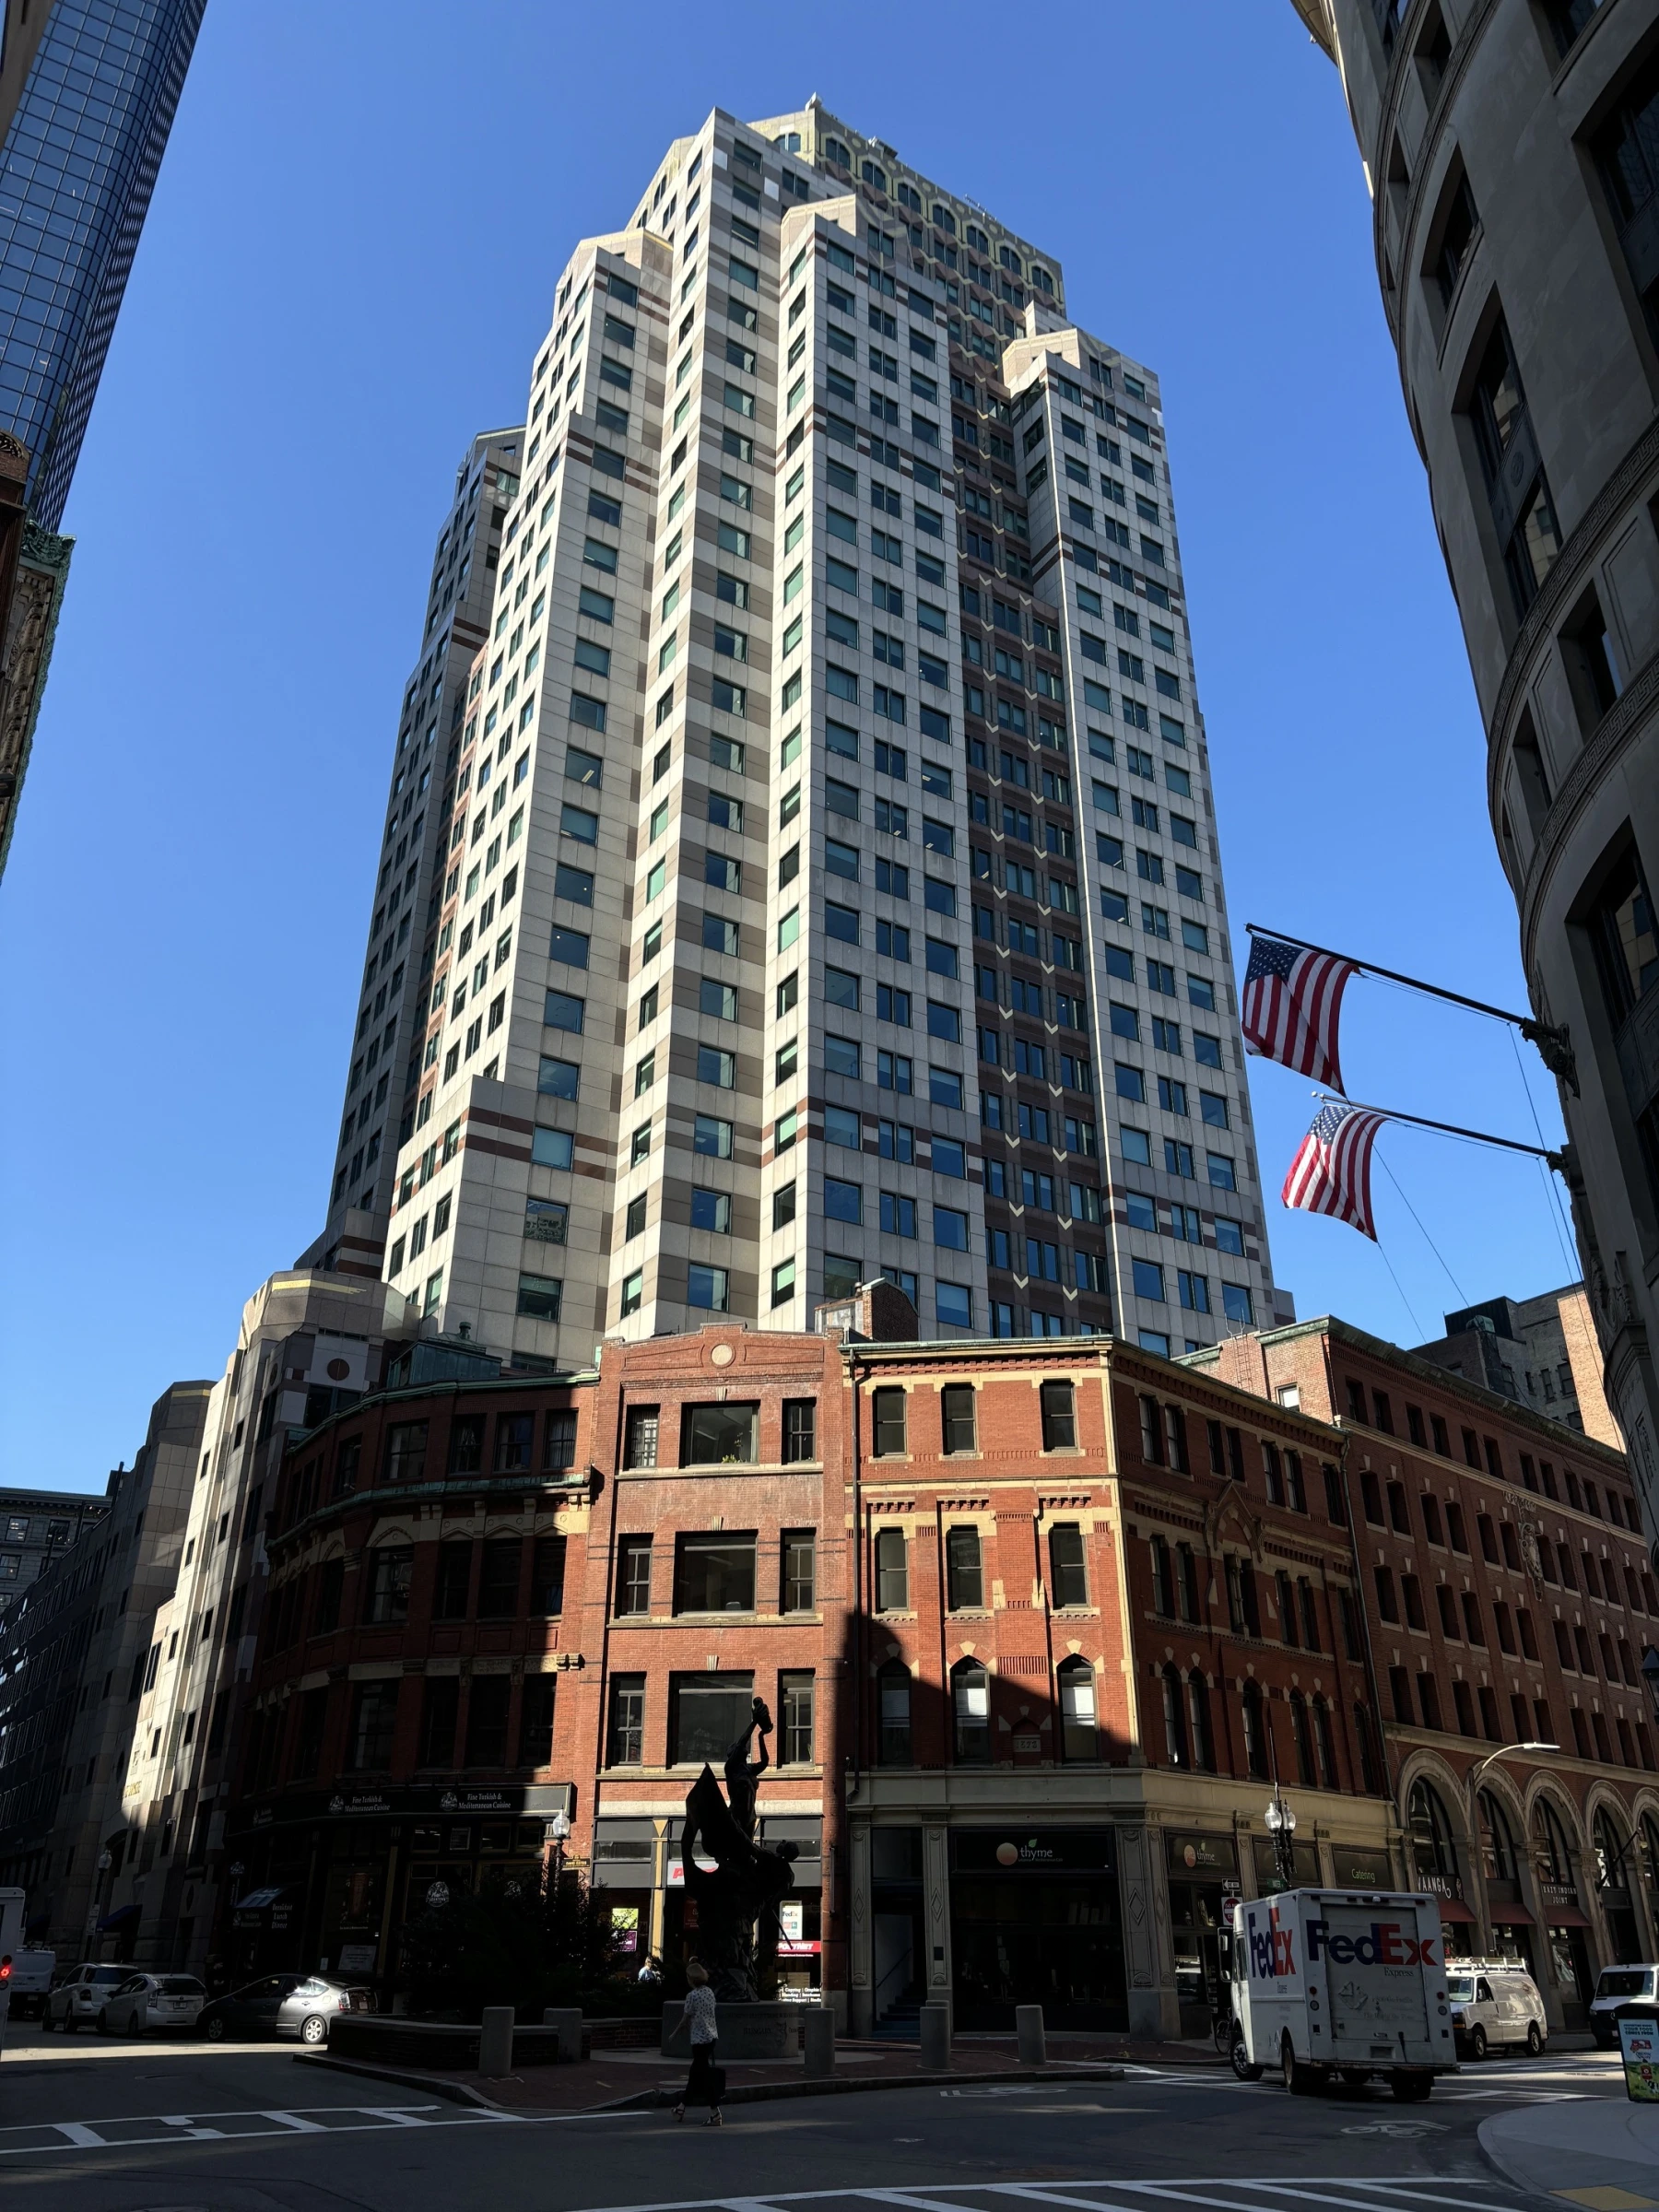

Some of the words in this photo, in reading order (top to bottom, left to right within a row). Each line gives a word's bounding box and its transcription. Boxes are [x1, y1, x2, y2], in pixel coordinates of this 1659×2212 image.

[362, 1795, 378, 1804] Turkish
[1019, 1845, 1053, 1861] thyme
[1196, 1847, 1216, 1864] thyme
[1351, 1868, 1376, 1883] Catering
[1558, 1886, 1577, 1895] INDIAN
[1552, 1896, 1568, 1904] JOINT
[272, 1902, 293, 1912] Breakfast
[273, 1912, 288, 1920] Lunch
[271, 1922, 288, 1930] Dinner
[1248, 1907, 1296, 1979] FedEx
[1306, 1919, 1439, 1966] FedEx
[1383, 1967, 1414, 1978] Express
